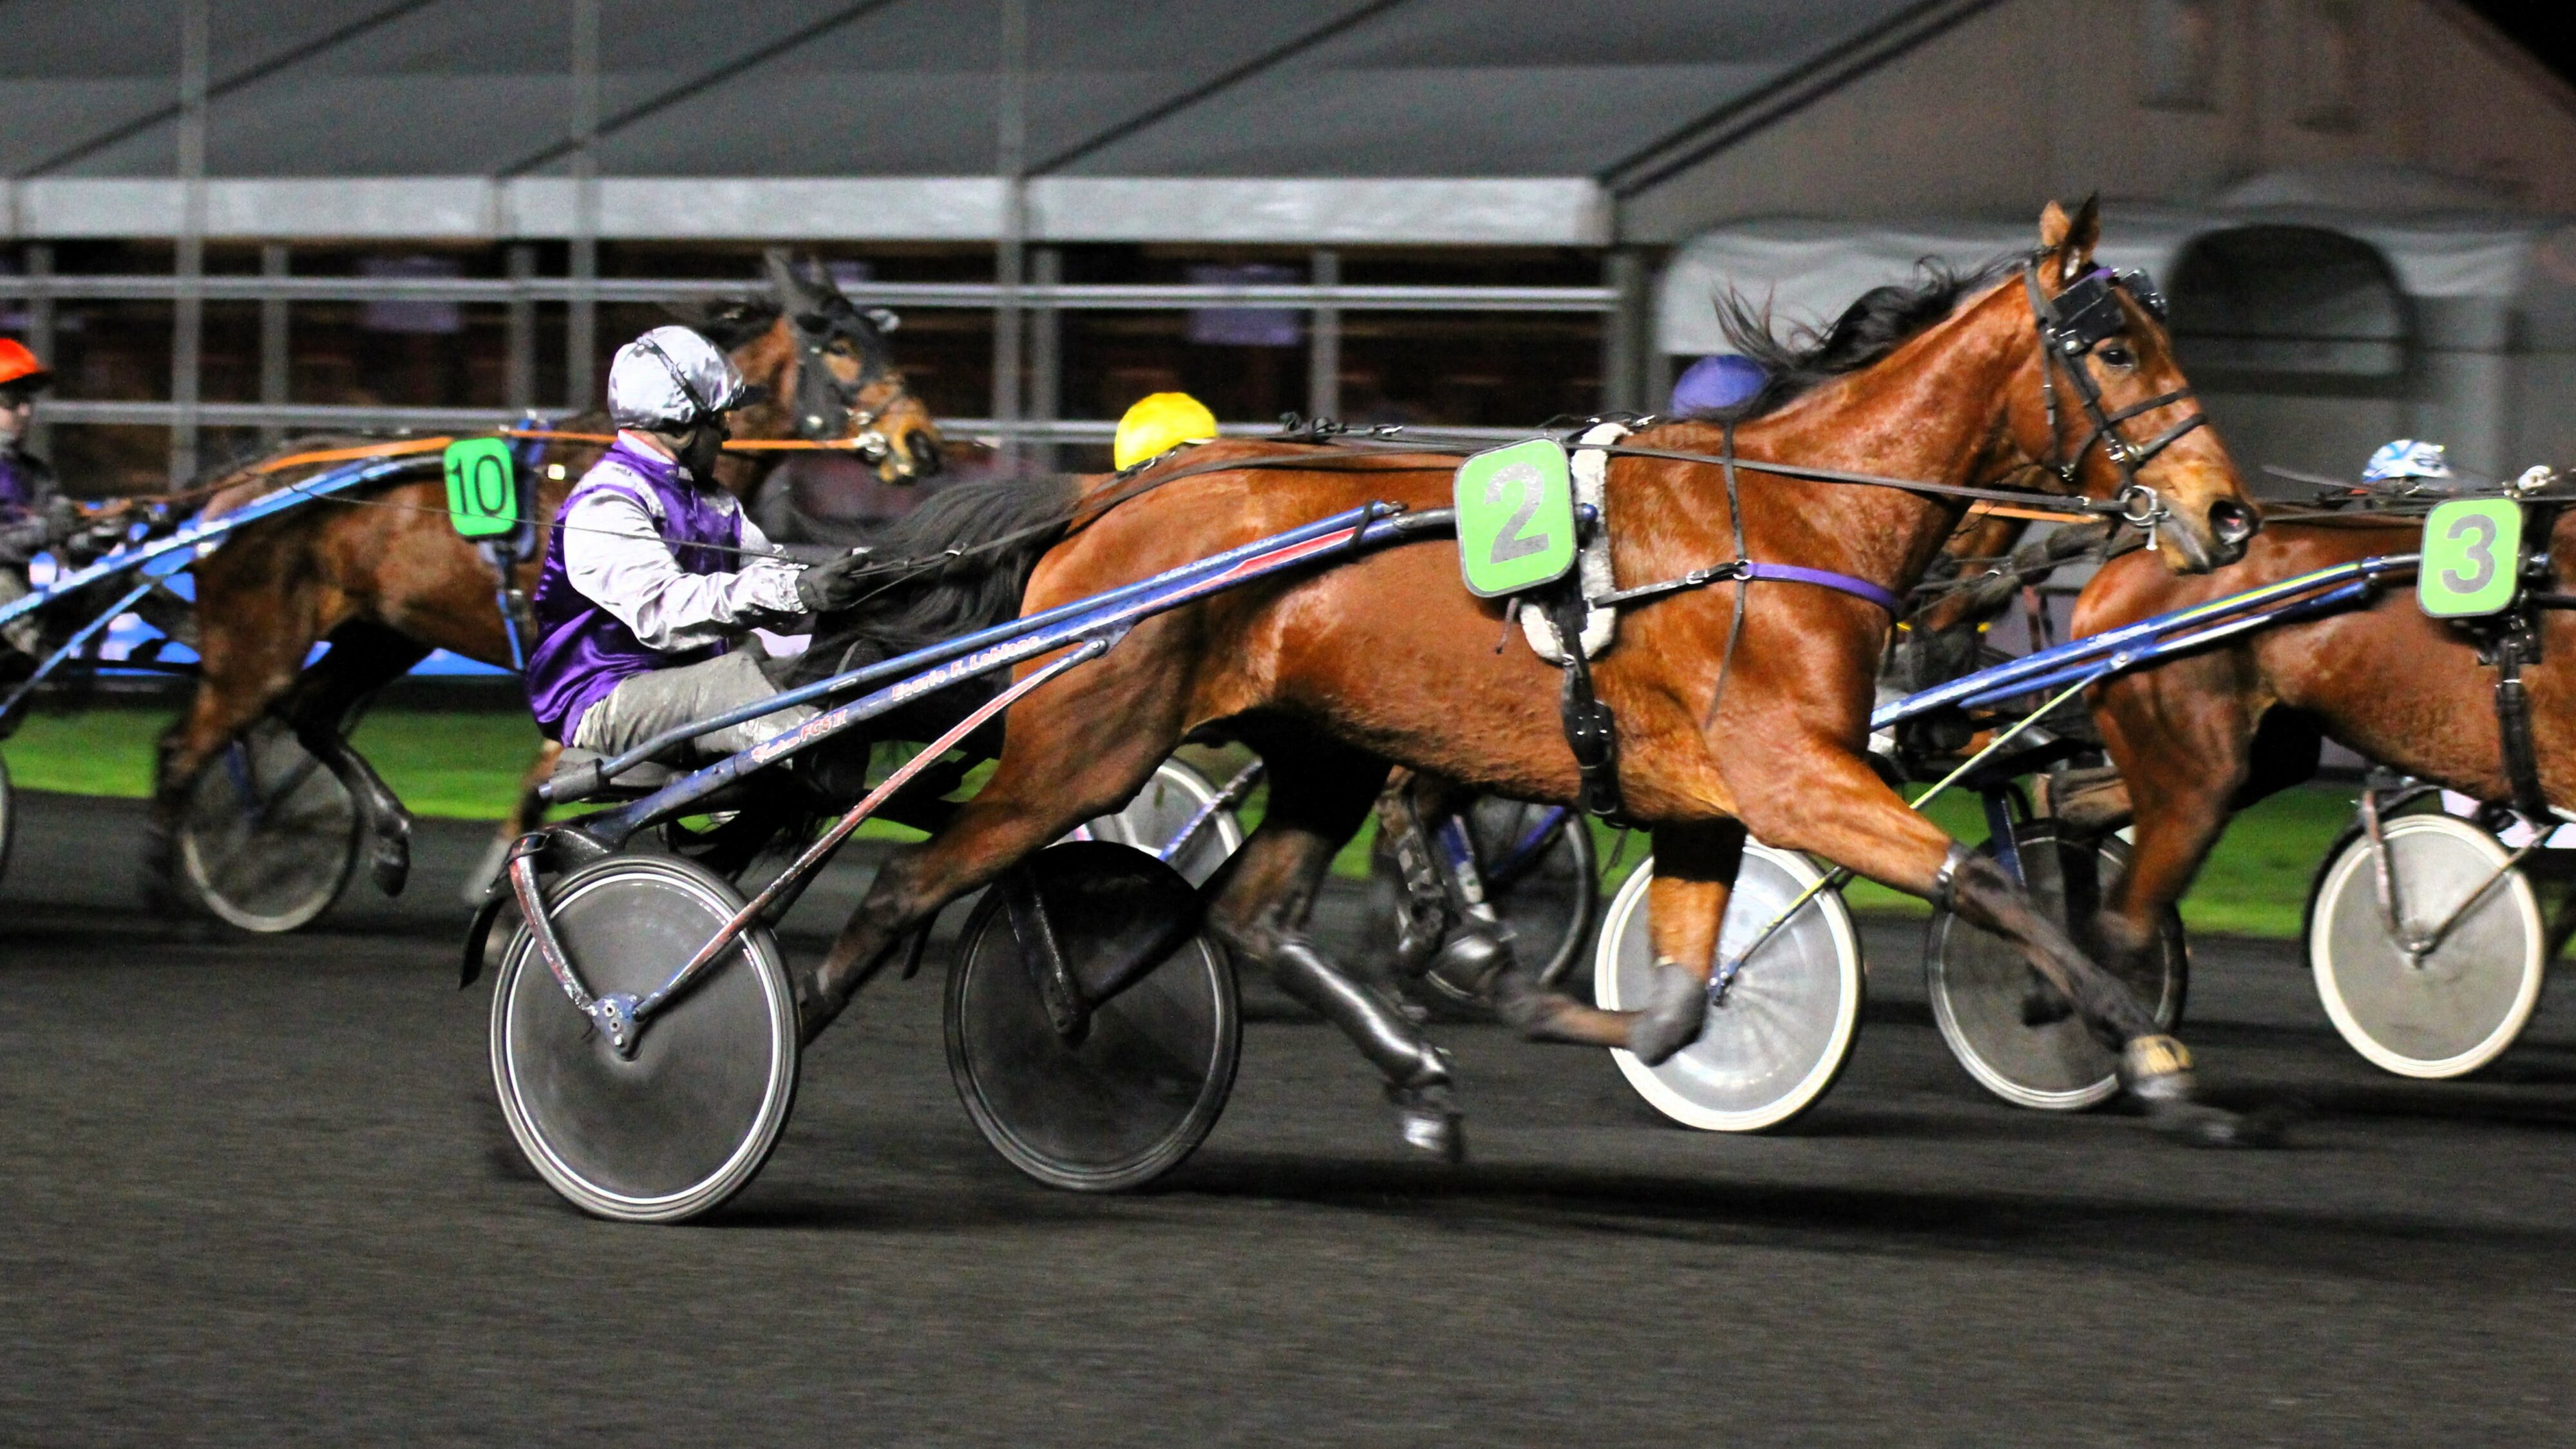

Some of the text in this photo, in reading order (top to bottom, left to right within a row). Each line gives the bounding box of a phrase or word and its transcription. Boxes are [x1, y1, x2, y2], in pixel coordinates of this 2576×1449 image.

[446, 455, 506, 517] 10
[1484, 462, 1549, 565] 2
[2441, 514, 2497, 594] 3
